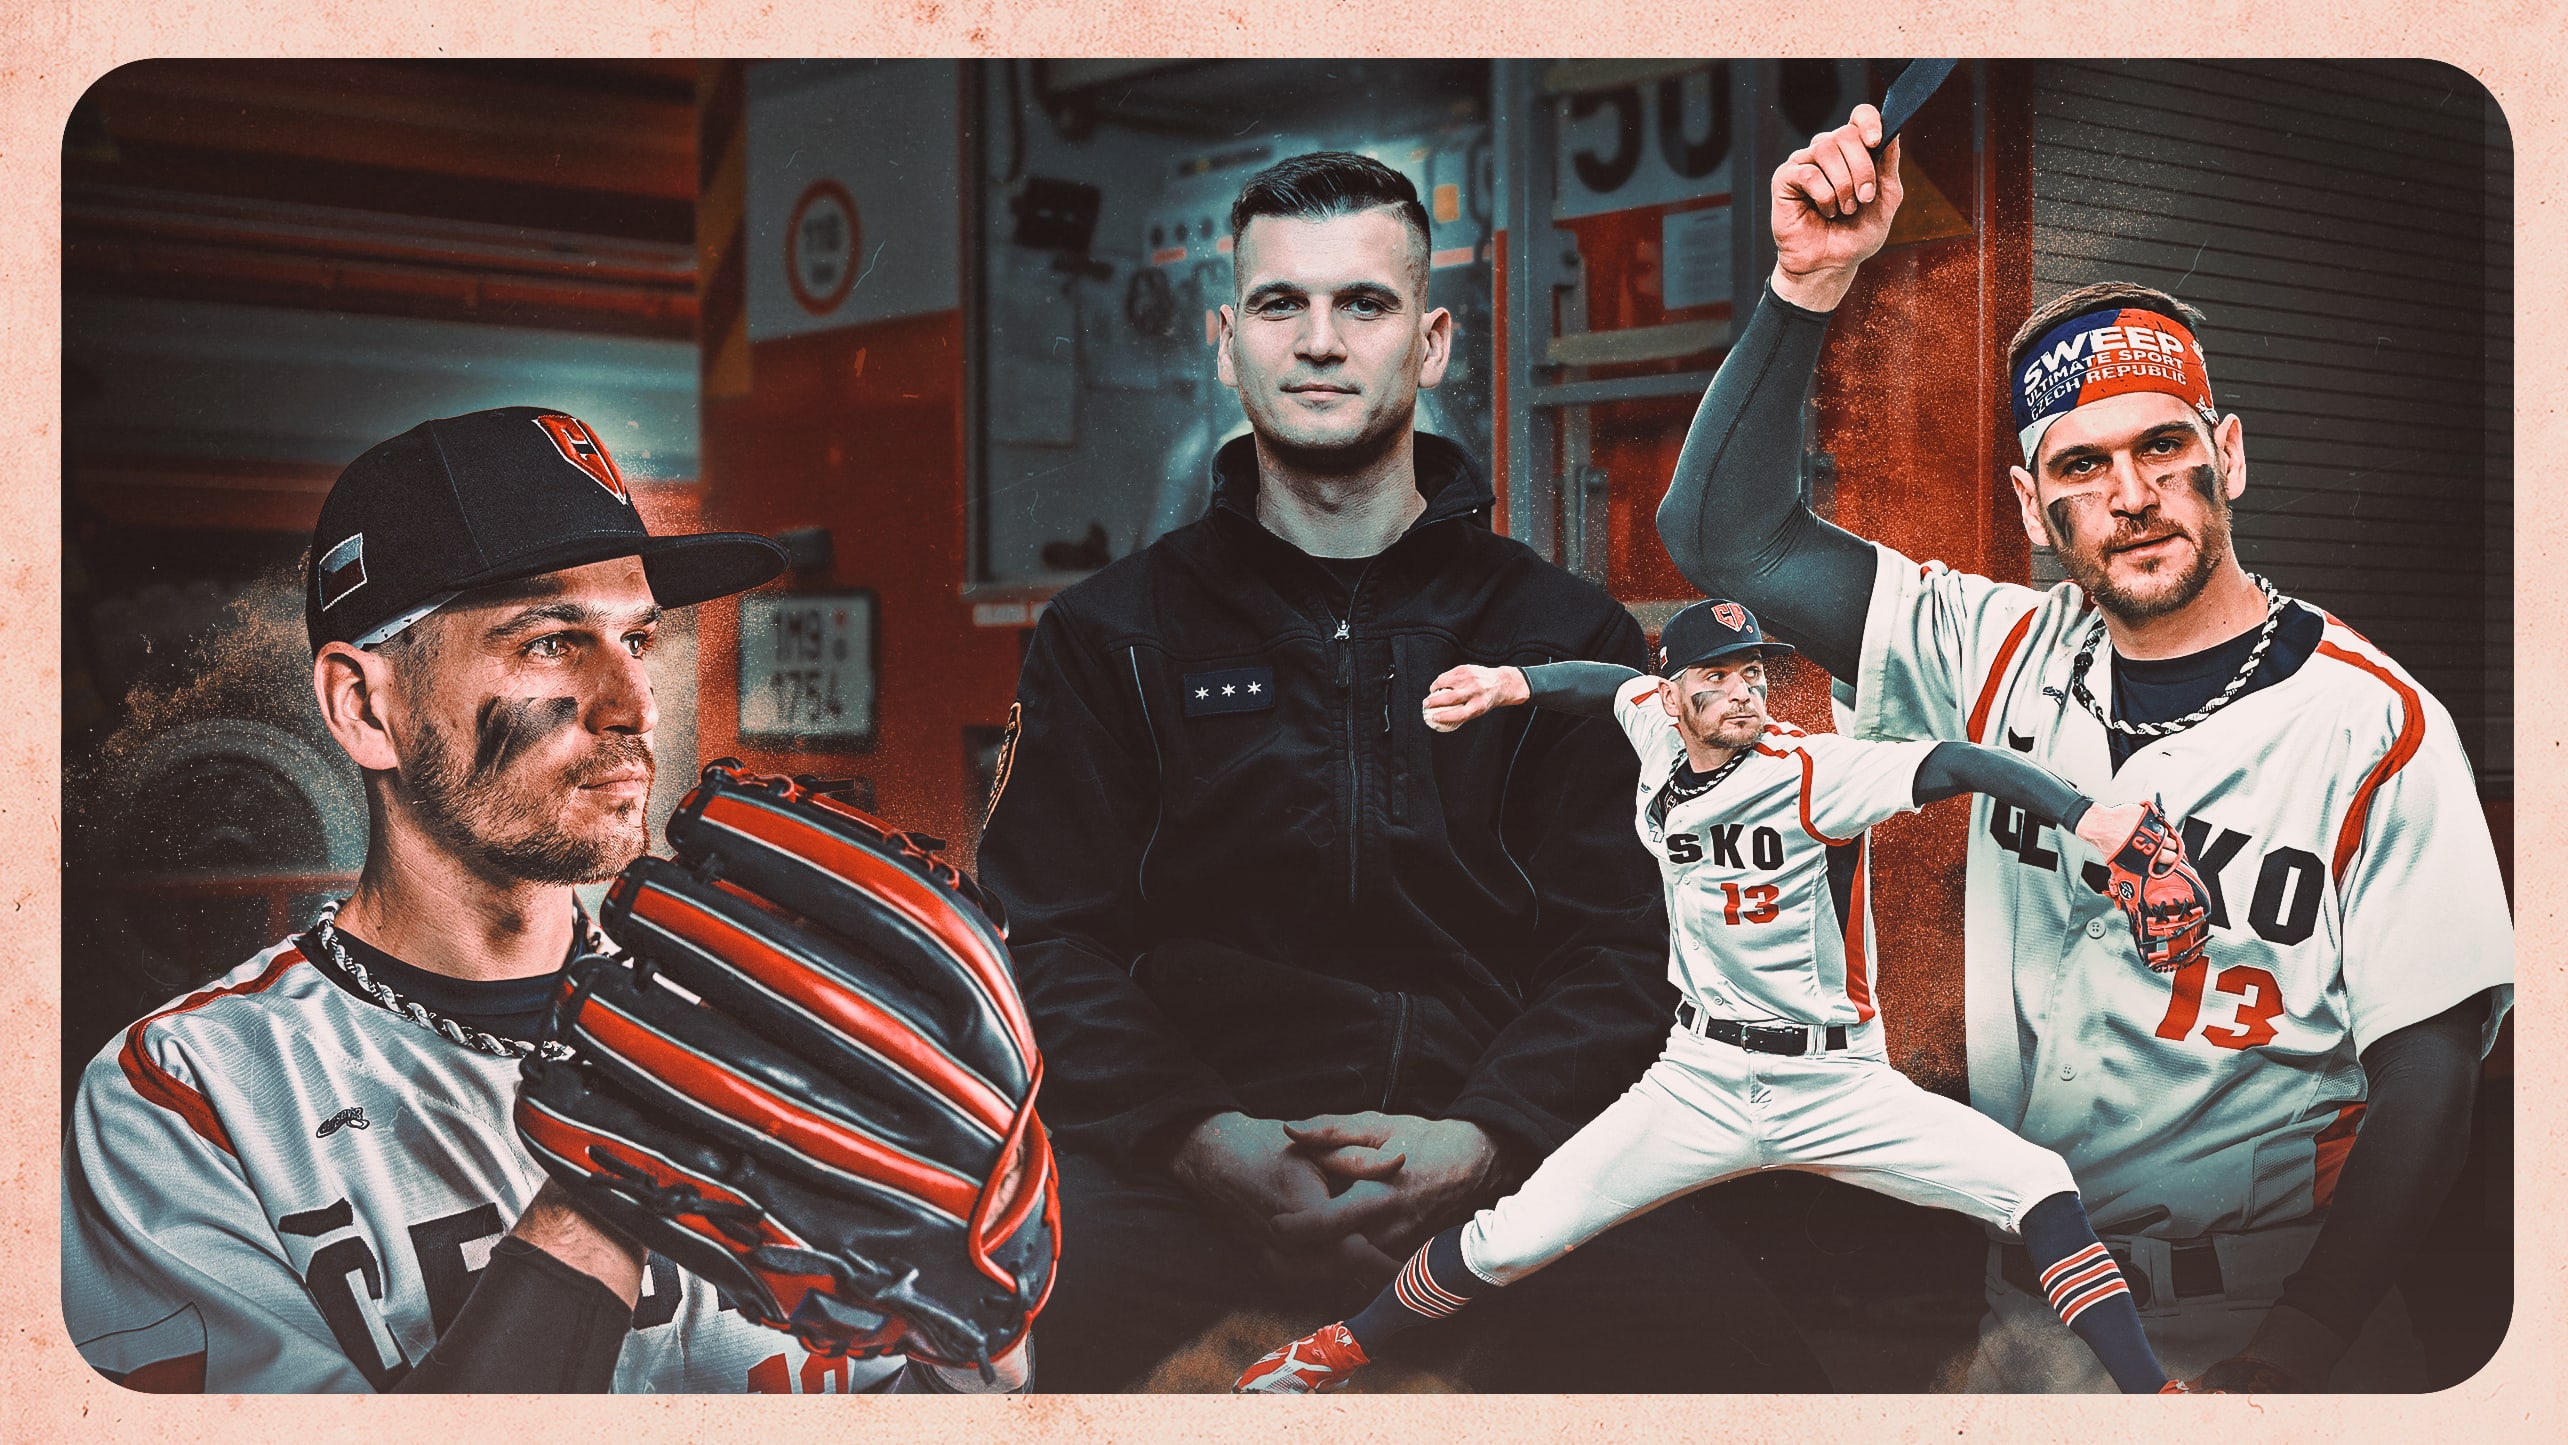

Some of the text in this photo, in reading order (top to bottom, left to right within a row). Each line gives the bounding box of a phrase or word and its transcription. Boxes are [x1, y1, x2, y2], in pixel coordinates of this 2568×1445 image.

[2024, 326, 2185, 395] SWEEP
[2027, 349, 2183, 407] ULTIMATE SPORT
[2031, 364, 2186, 421] CZECH REPUBLIC
[1720, 882, 1779, 925] 13
[2155, 955, 2285, 1051] 13
